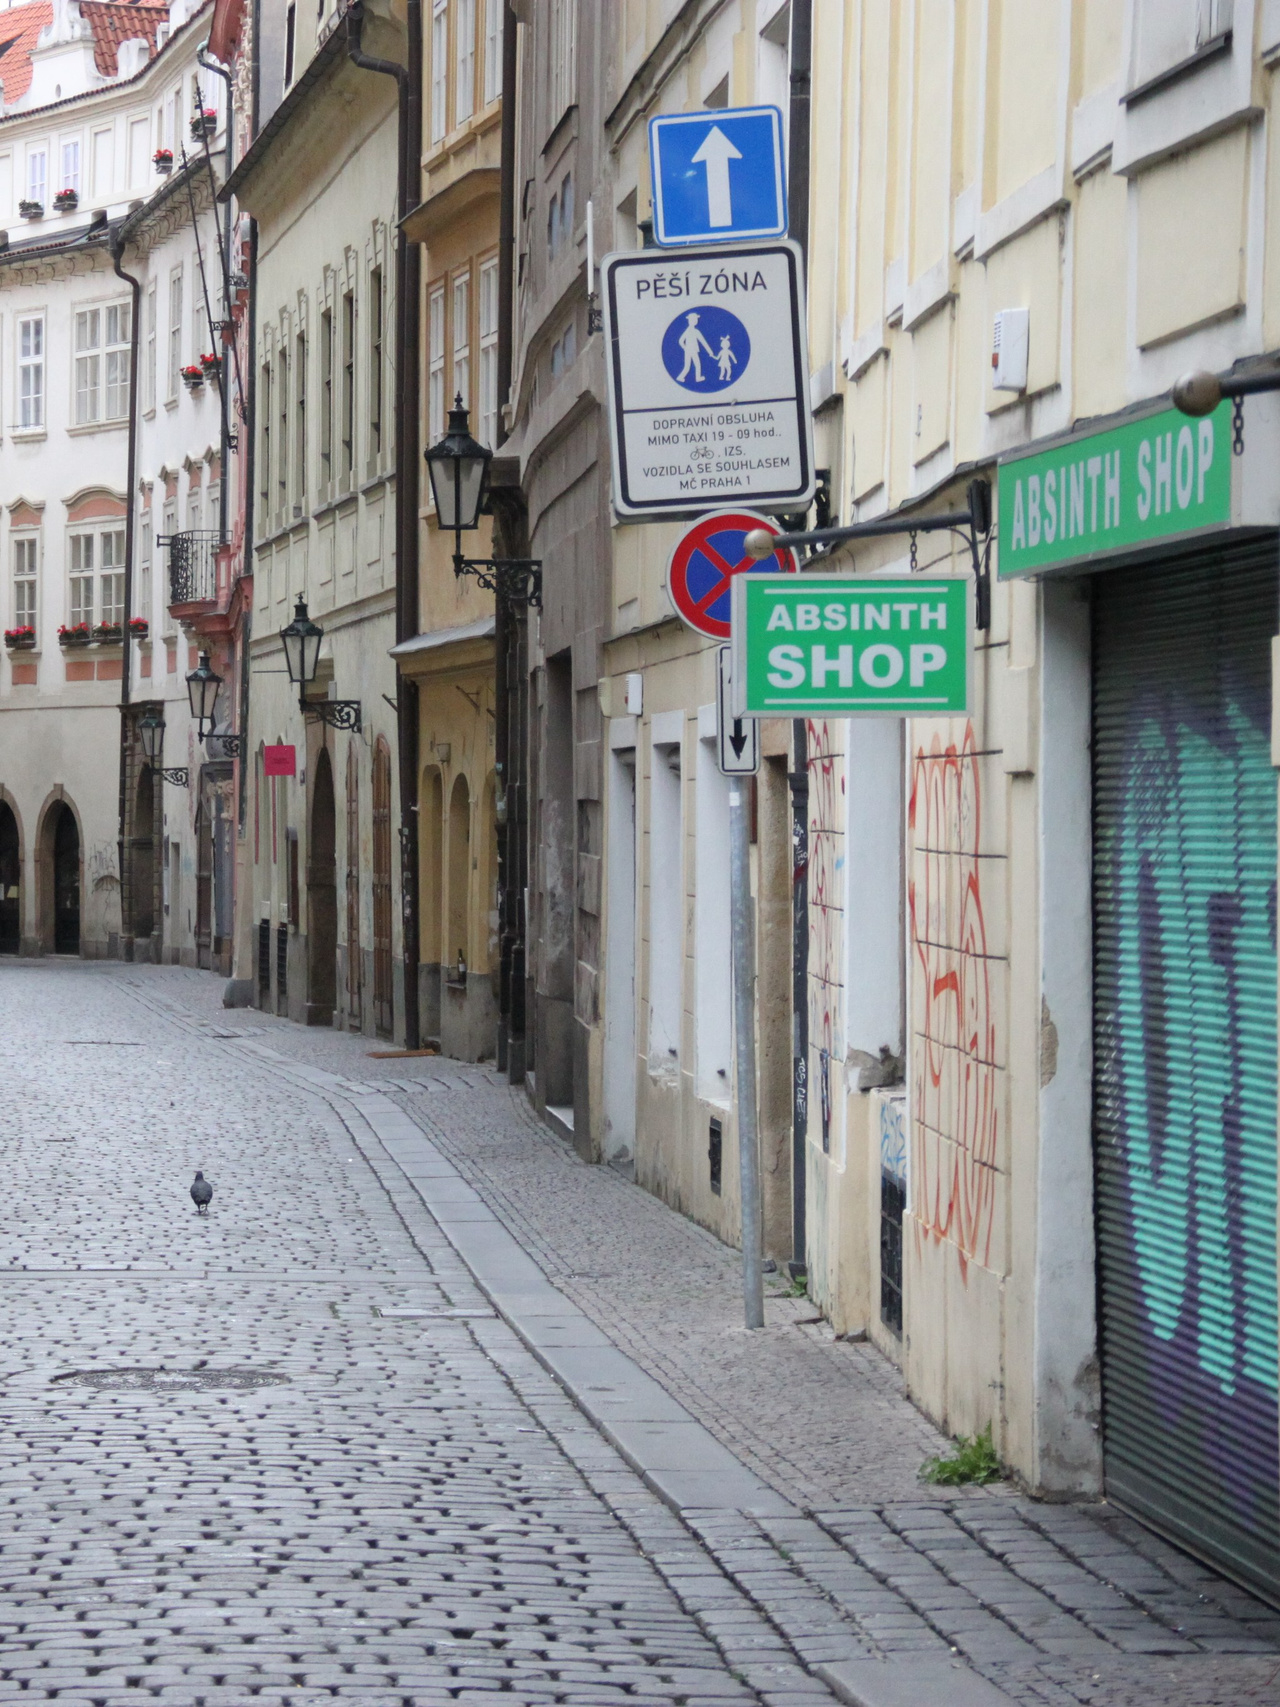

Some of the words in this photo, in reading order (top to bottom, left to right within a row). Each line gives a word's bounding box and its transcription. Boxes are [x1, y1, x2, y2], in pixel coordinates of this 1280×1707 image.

[636, 271, 690, 300] PĚŠÍ
[699, 268, 767, 295] ZÓNA
[653, 414, 714, 431] DOPRAVNÍ
[717, 411, 775, 426] OBSLUHA
[647, 434, 680, 447] MIMO
[683, 432, 708, 443] TAXI
[712, 431, 725, 442] 19
[737, 429, 751, 440] 09
[642, 464, 694, 478] VOZIDLA
[697, 462, 713, 474] SE
[715, 457, 791, 473] SOUHLASEM
[679, 477, 698, 491] MČ
[700, 475, 743, 489] PRAHA
[746, 475, 751, 485] 1
[1011, 449, 1121, 551] ABSINTH
[1137, 418, 1215, 522] SHOP
[766, 602, 947, 632] ABSINTH
[766, 643, 948, 689] SHOP
